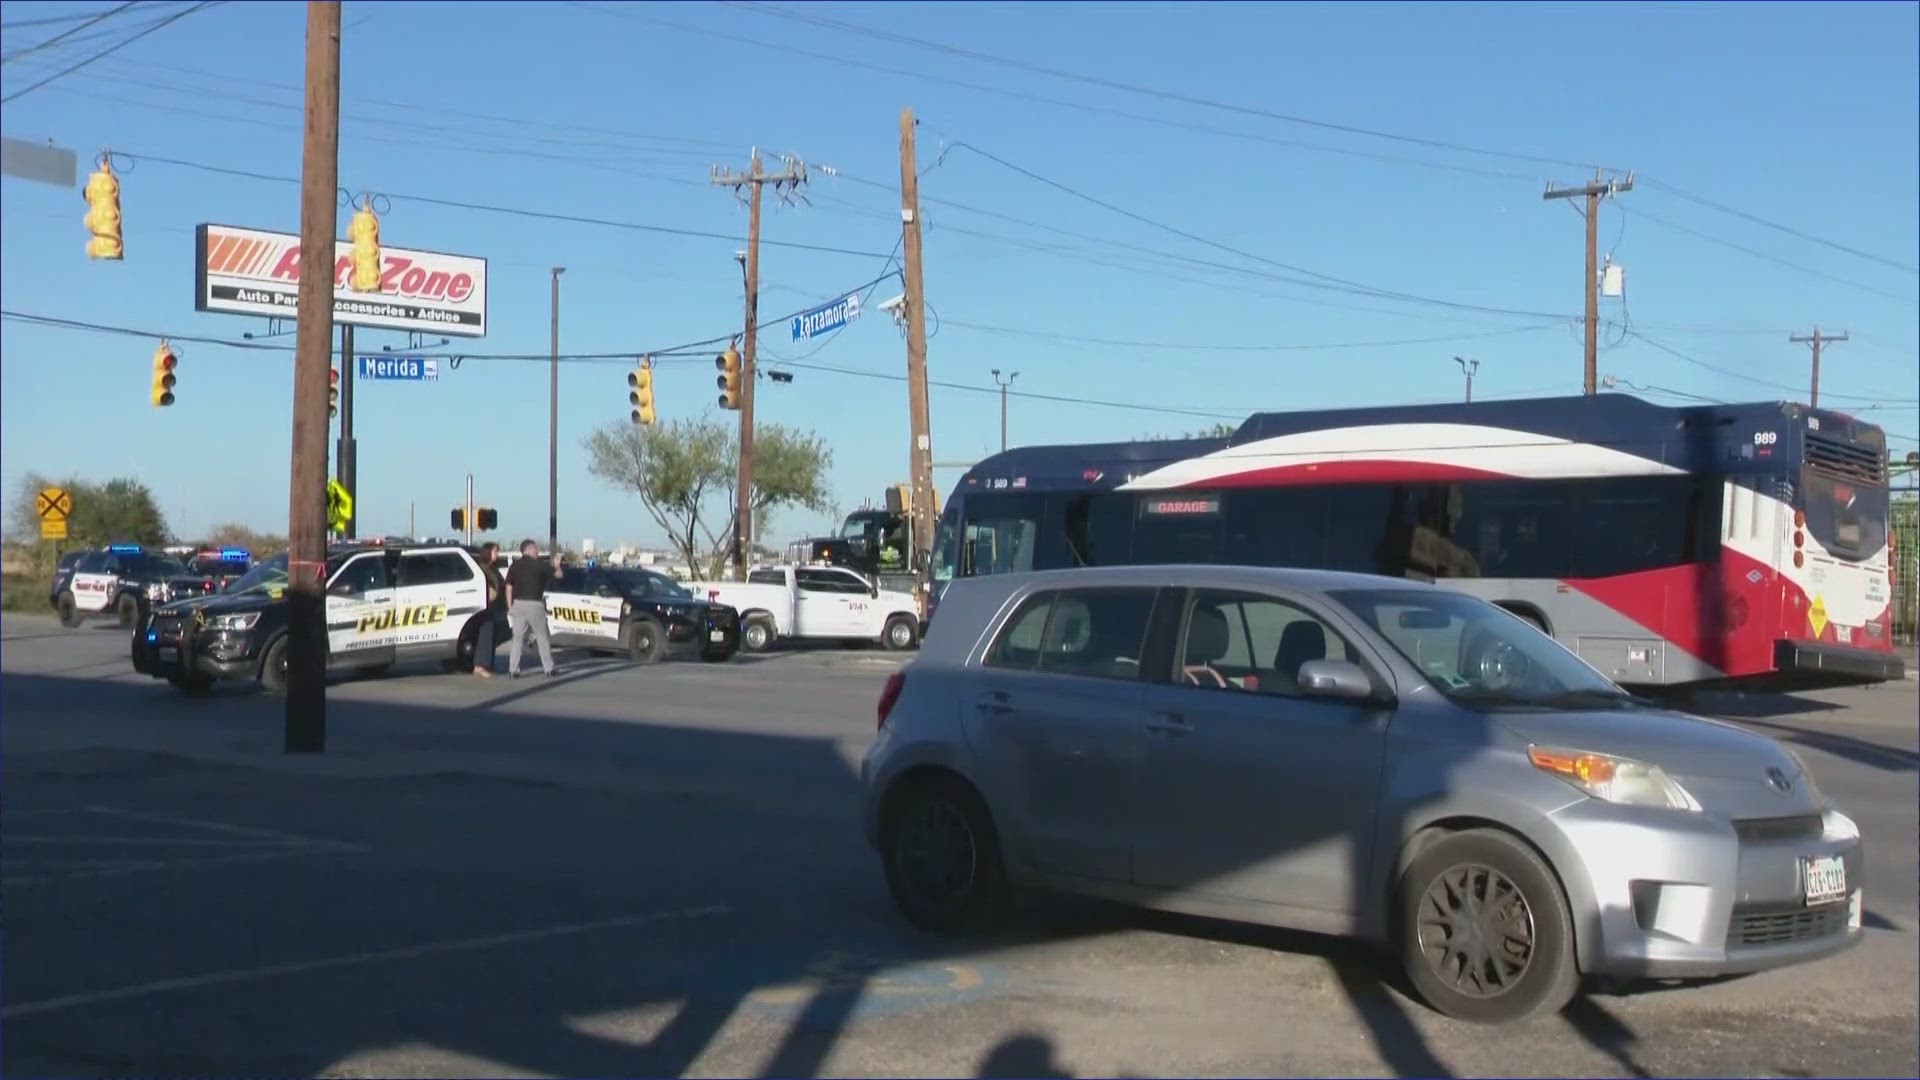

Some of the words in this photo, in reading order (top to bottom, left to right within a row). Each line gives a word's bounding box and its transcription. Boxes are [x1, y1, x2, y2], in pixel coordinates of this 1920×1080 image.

[236, 289, 270, 303] Auto
[274, 293, 298, 306] Par
[334, 301, 405, 317] ccessories
[418, 309, 460, 322] Advice
[800, 301, 849, 335] Zarzamora
[366, 359, 418, 376] Merida
[1754, 432, 1777, 445] 989
[1158, 501, 1208, 512] GARAGE
[359, 604, 446, 632] POLICE
[553, 607, 601, 624] POLICE
